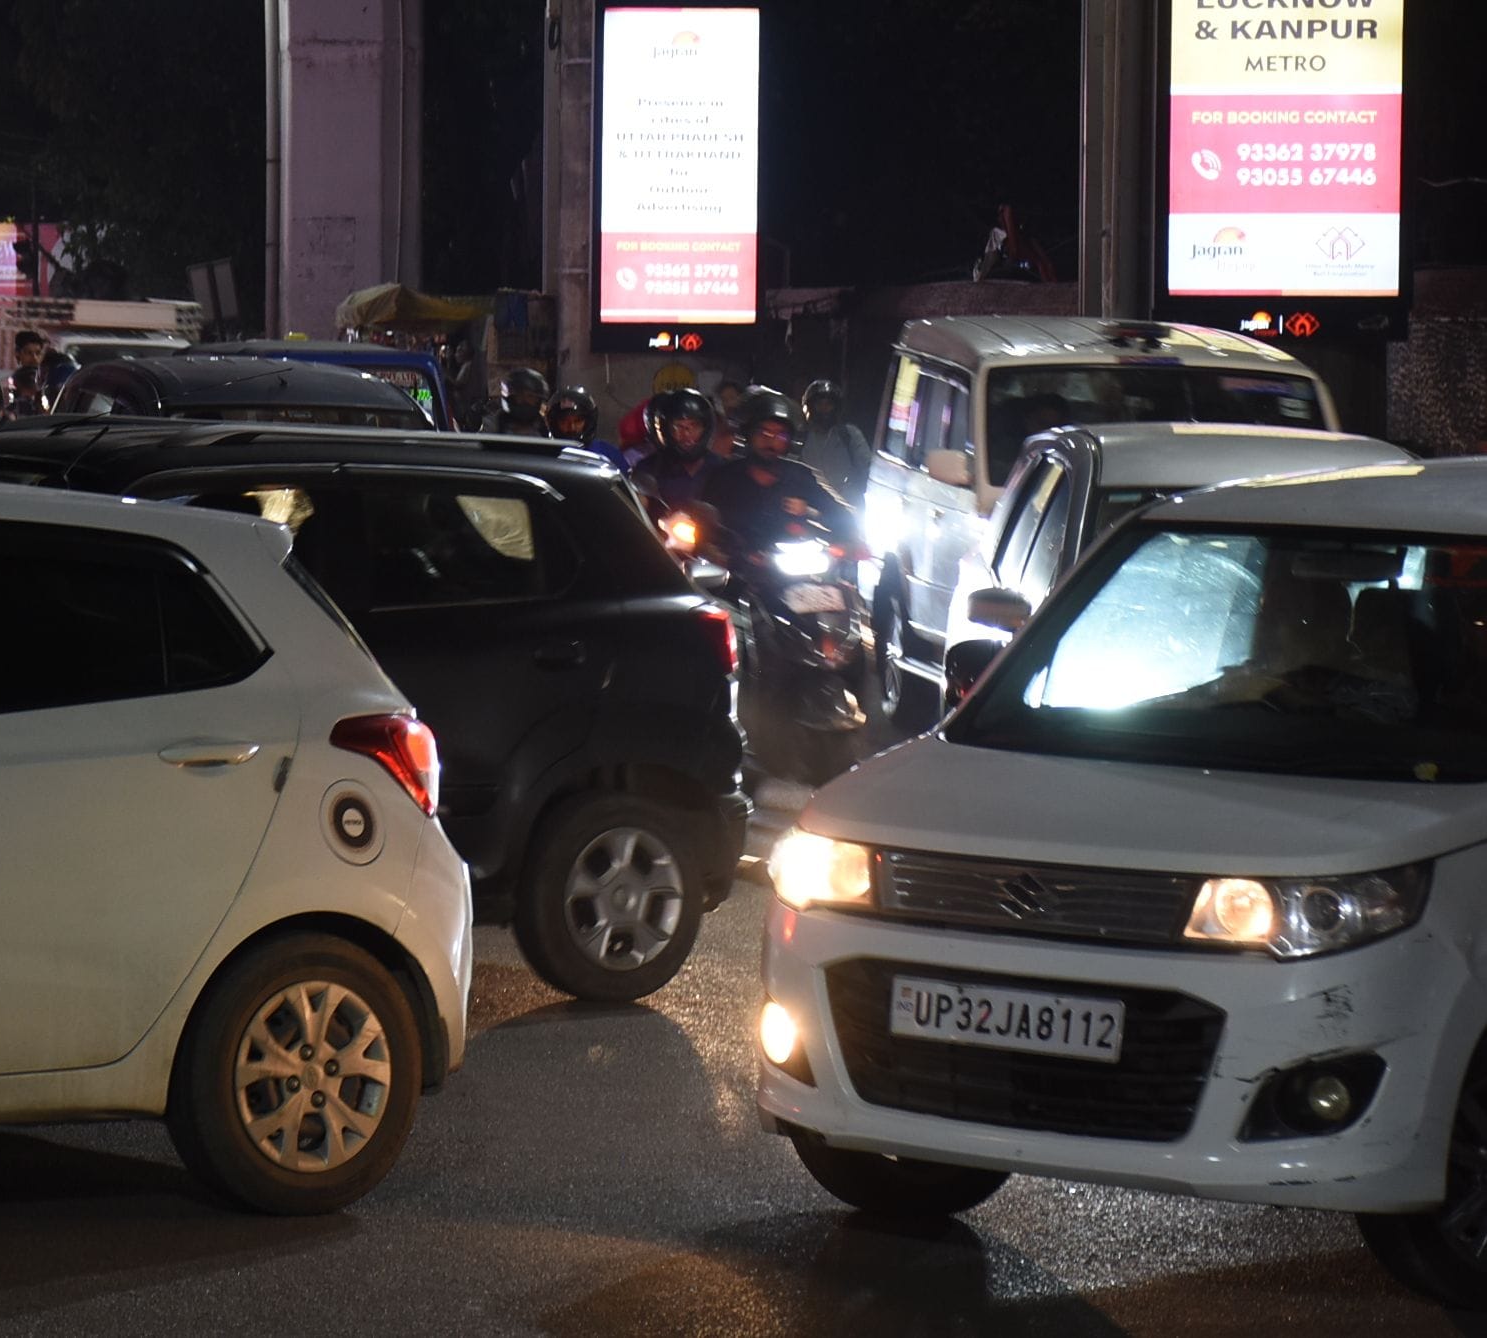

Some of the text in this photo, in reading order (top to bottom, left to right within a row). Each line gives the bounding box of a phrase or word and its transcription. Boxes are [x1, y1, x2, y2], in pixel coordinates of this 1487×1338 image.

[1194, 18, 1379, 40] & KANPUR
[1244, 54, 1327, 72] METRO
[1191, 110, 1378, 125] FOR BOOKING CONTACT
[1236, 142, 1377, 162] 93362 37978
[1236, 167, 1377, 186] 93055 67446
[615, 240, 639, 252] FOR
[691, 240, 742, 252] CONTACT
[1189, 244, 1244, 259] Jagran
[914, 990, 1117, 1049] UP32JA8112
